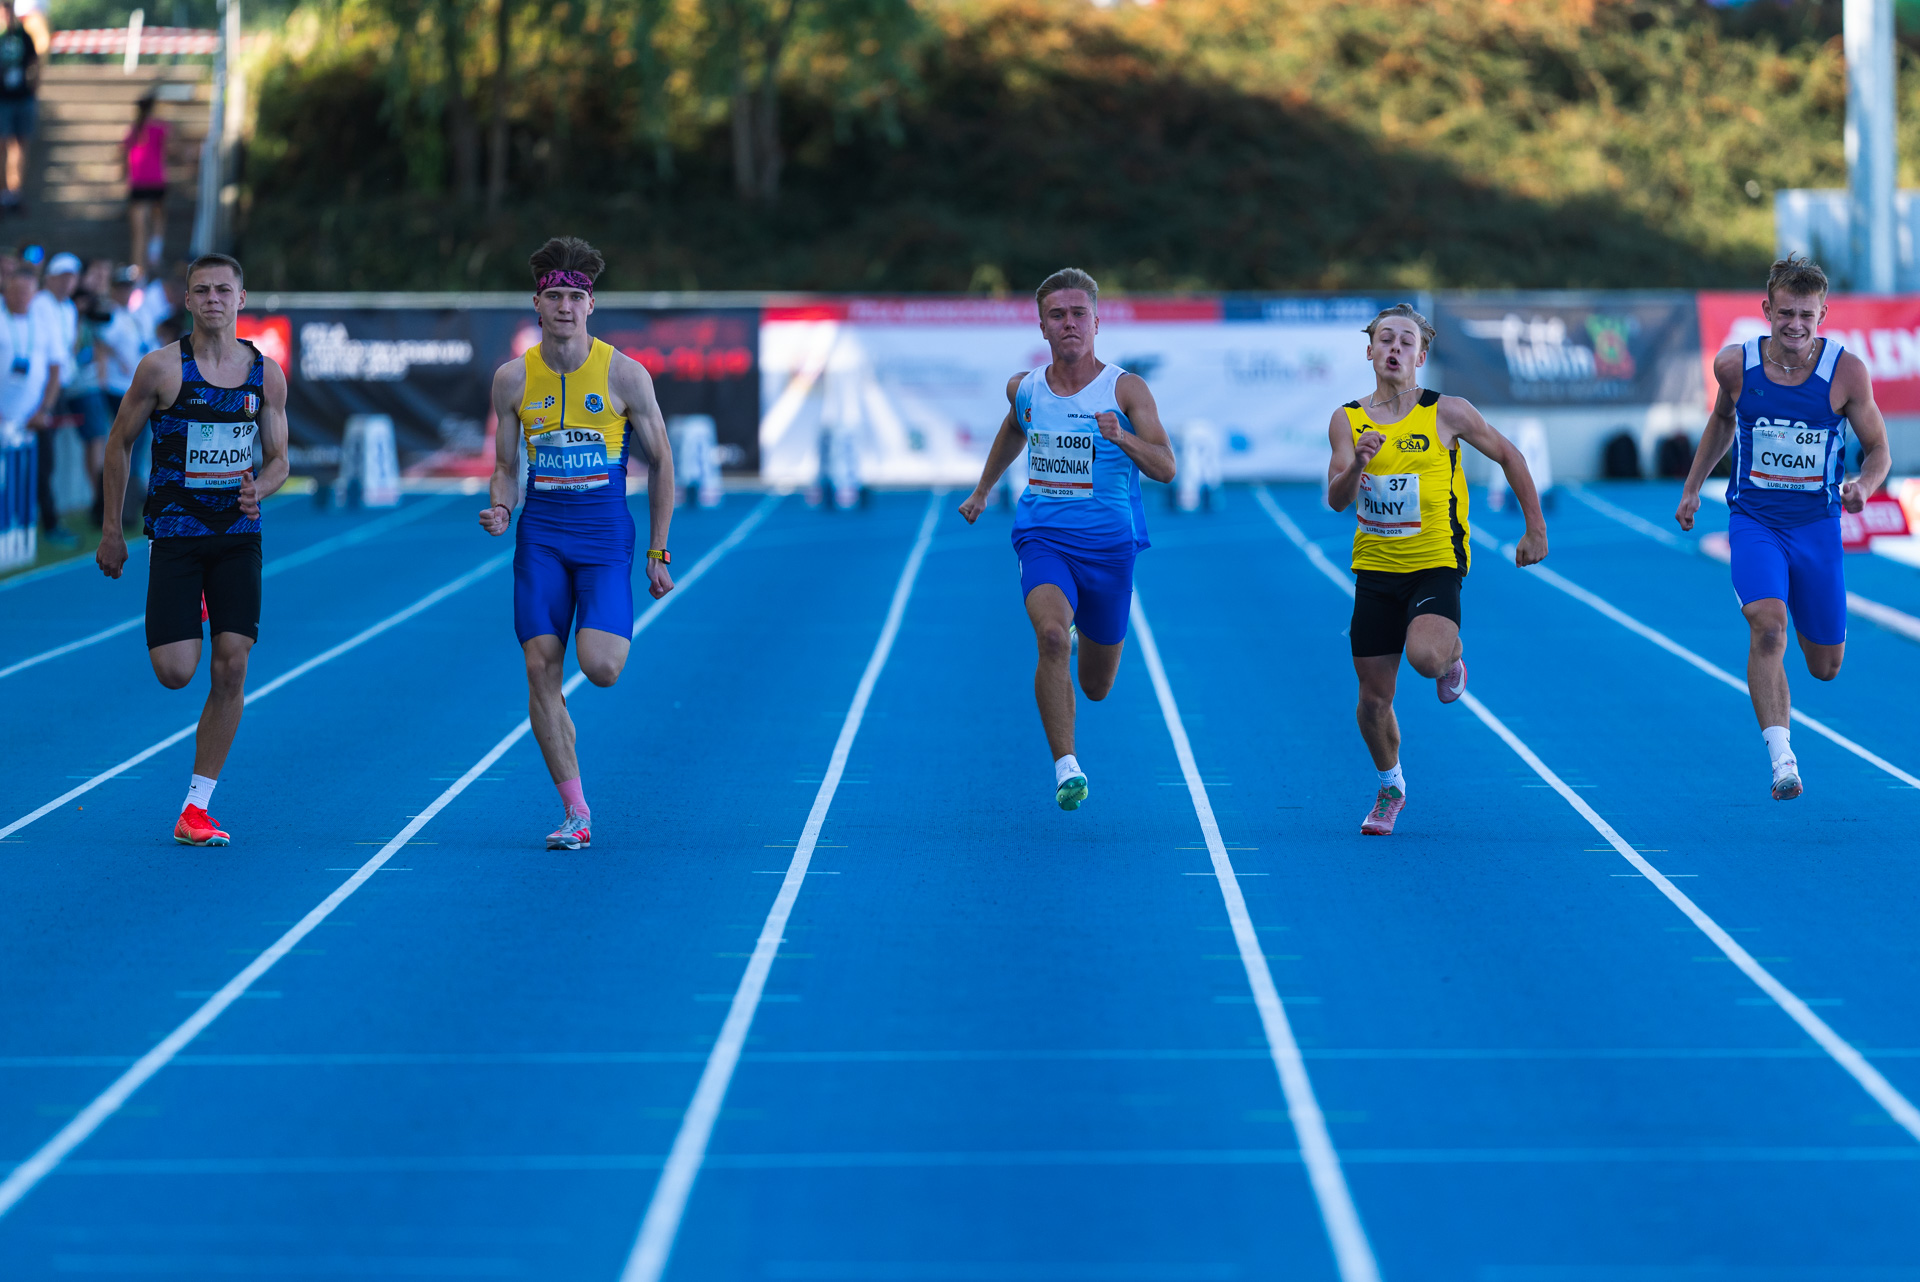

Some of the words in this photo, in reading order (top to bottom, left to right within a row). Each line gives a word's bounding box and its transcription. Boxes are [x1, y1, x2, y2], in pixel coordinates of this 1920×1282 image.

[232, 424, 254, 438] 918
[565, 430, 603, 443] 1012
[1056, 435, 1091, 449] 1080
[1795, 432, 1821, 445] 681
[189, 445, 252, 467] PRZĄDKA
[538, 451, 604, 469] RACHUTA
[1761, 451, 1816, 469] CYGAN
[1031, 456, 1090, 475] PRZEWOŹNIAK
[1389, 478, 1408, 491] 37
[1364, 498, 1405, 516] PILNY
[1366, 526, 1386, 534] LUBLIN
